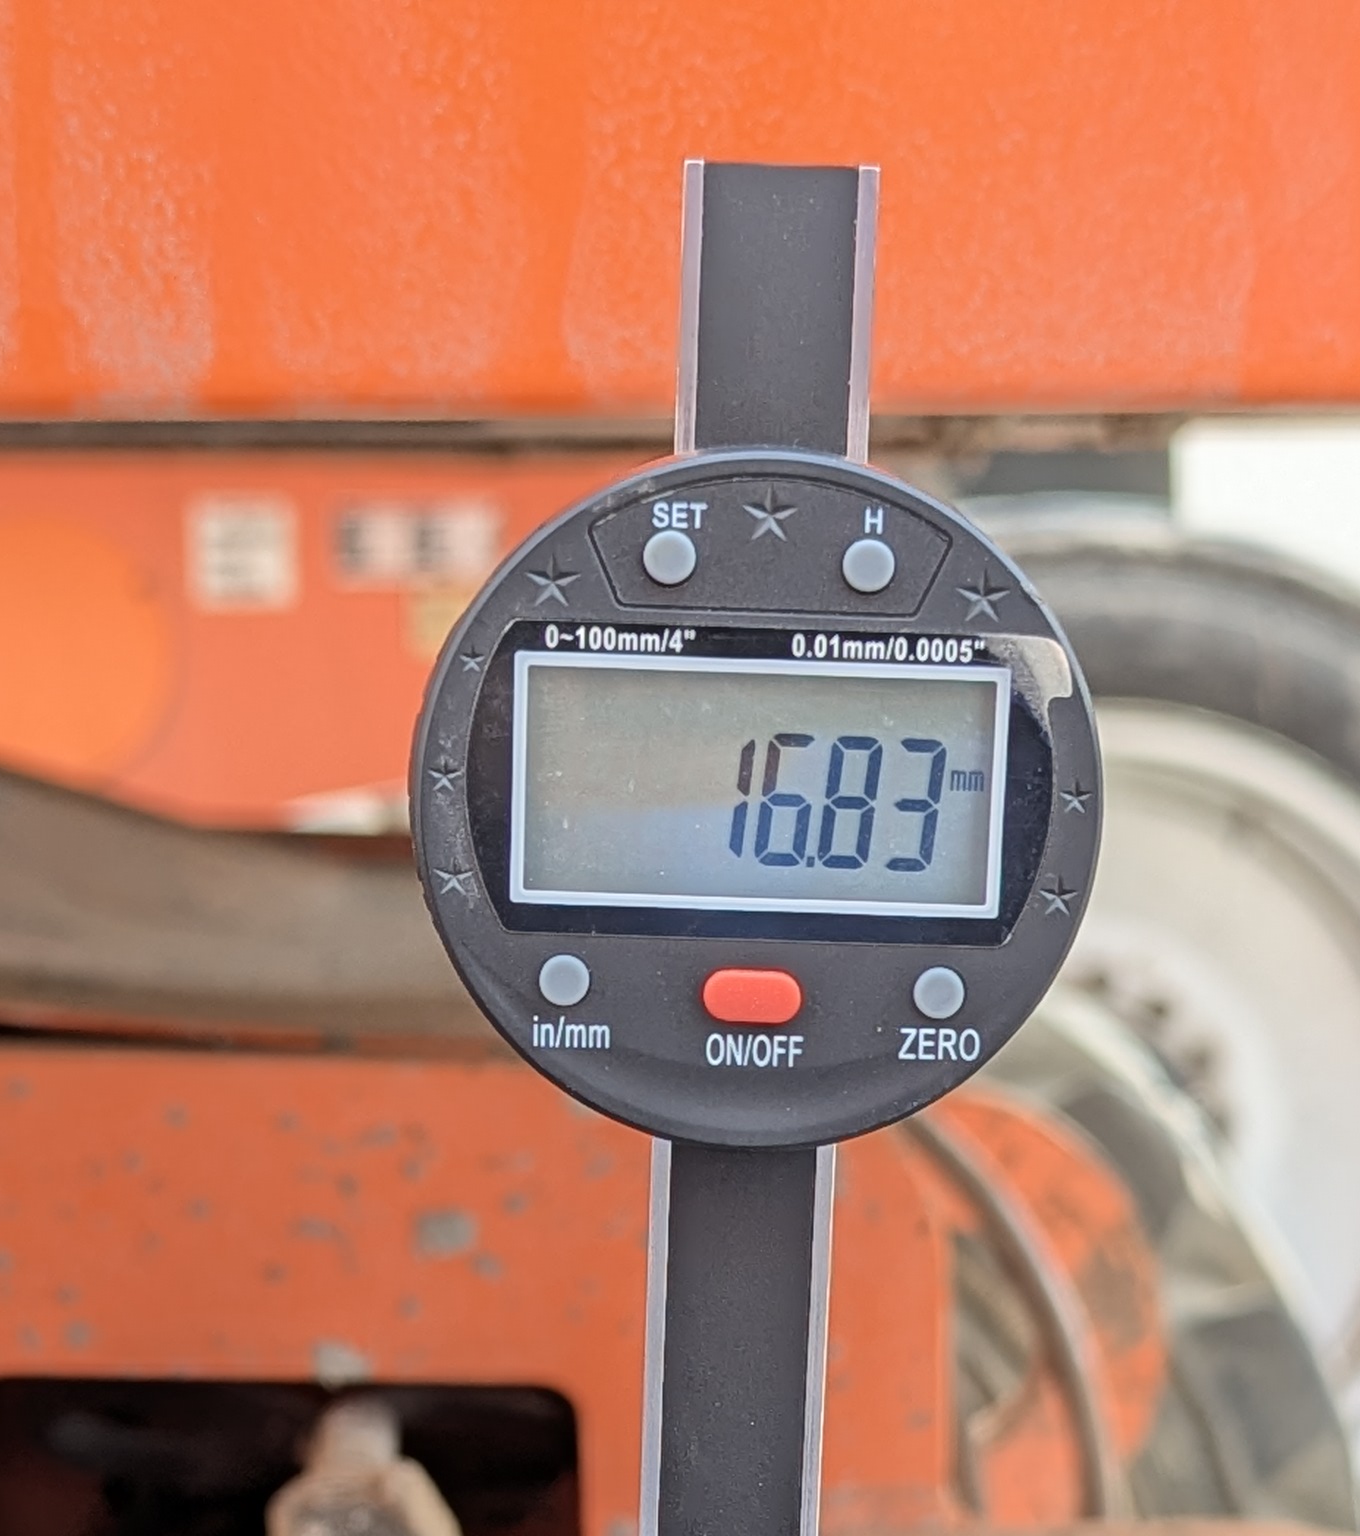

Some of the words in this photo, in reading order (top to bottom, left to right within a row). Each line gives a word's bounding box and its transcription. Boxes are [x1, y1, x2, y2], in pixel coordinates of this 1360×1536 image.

[652, 502, 708, 531] SET
[864, 507, 884, 536] H
[728, 732, 947, 873] 16.83
[949, 769, 985, 793] mm
[532, 1015, 611, 1050] in/mm
[897, 1027, 981, 1062] ZERO
[705, 1033, 805, 1068] ON/OFF
